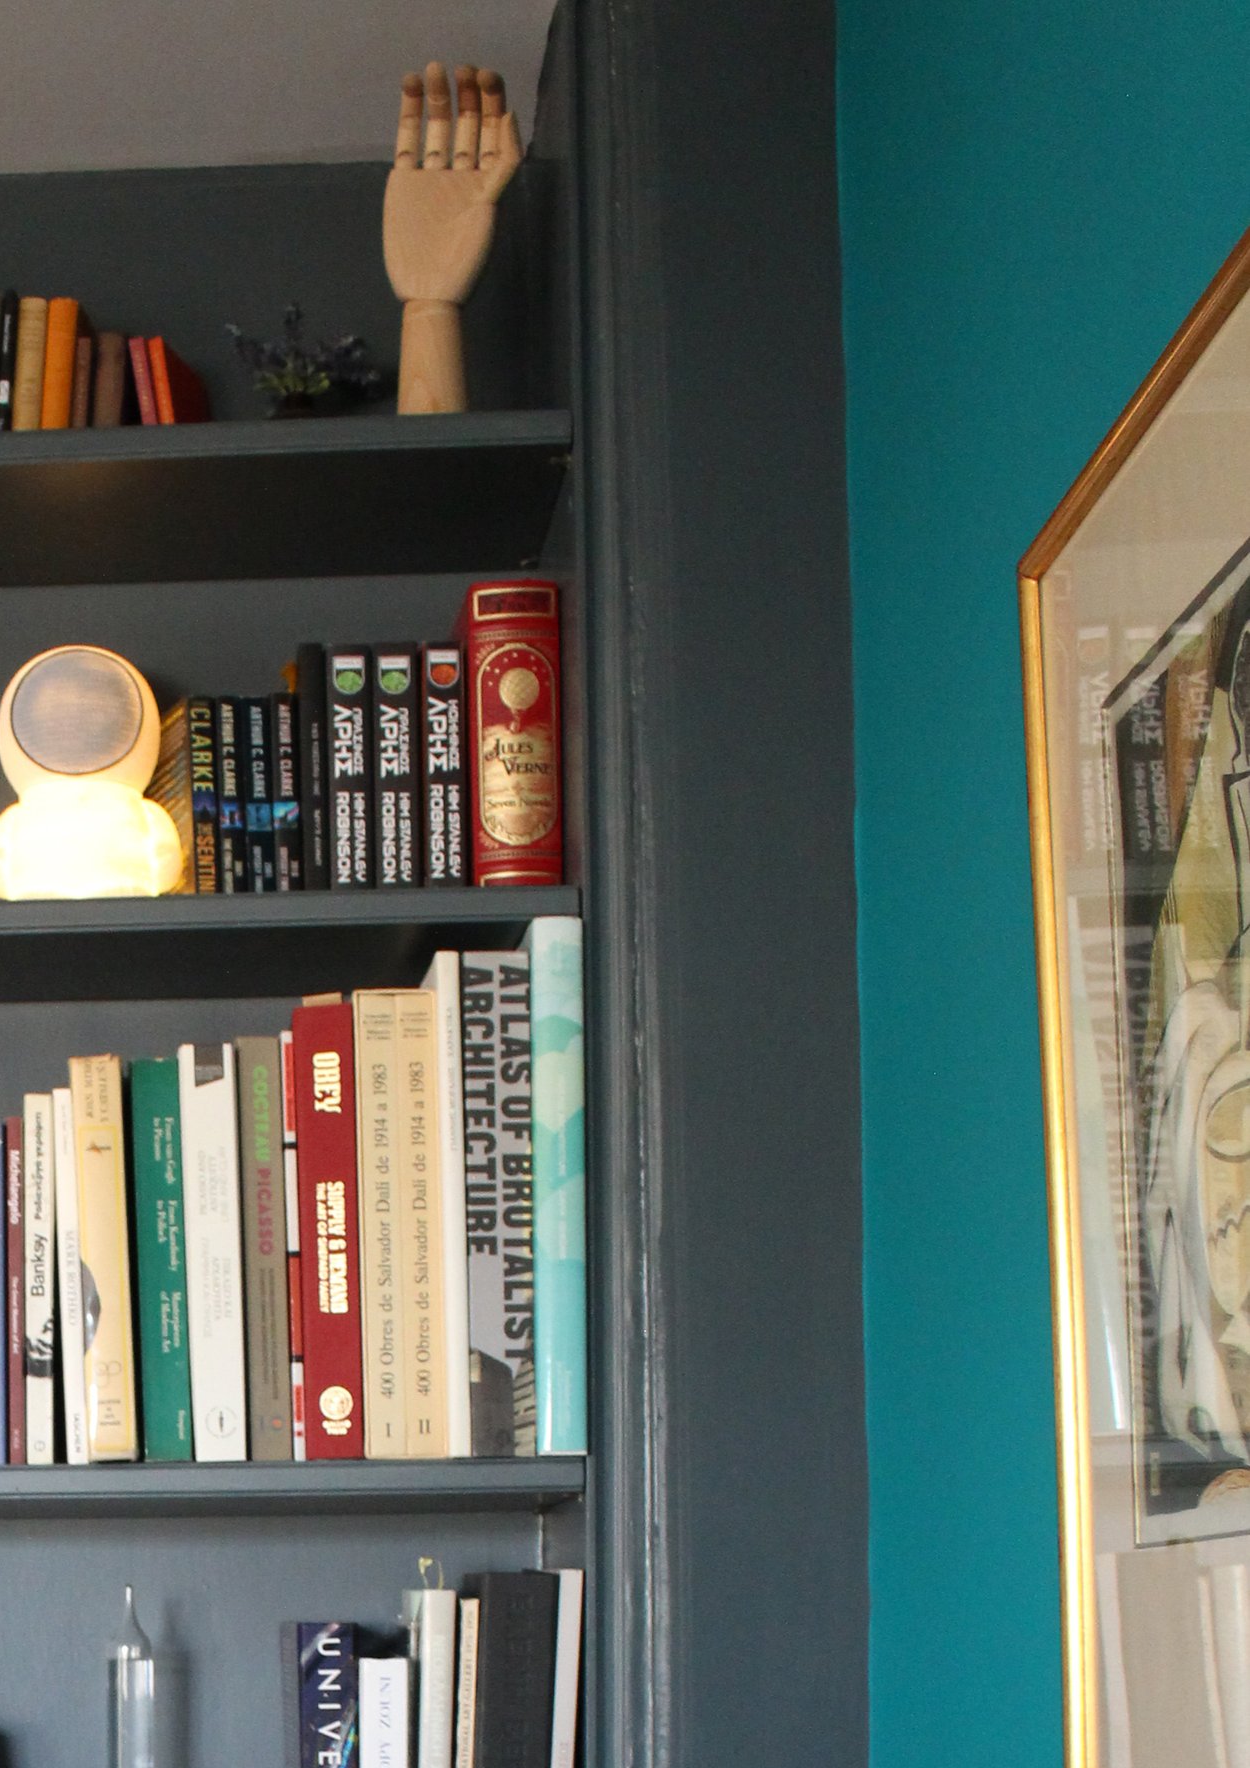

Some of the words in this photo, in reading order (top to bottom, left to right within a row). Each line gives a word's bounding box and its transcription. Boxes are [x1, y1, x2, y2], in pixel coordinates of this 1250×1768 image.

[221, 704, 235, 744] ARTHUR
[250, 706, 263, 745] ARTHUR
[278, 704, 291, 743] ARTHUR
[190, 707, 214, 793] CLARKE
[223, 746, 233, 756] C.
[252, 748, 261, 758] C.
[280, 746, 290, 756] C.
[485, 737, 534, 760] JULES
[501, 757, 553, 776] VERNE
[222, 759, 236, 797] CLARKE
[252, 760, 266, 799] CLARKE
[280, 759, 293, 797] CLARKE
[353, 793, 365, 817] KIM
[399, 793, 411, 817] KIM
[448, 785, 460, 810] KIM
[336, 792, 352, 883] ROBINSON
[382, 792, 397, 883] ROBINSON
[429, 784, 445, 879] ROBINSON
[448, 812, 460, 878] STANLEY
[354, 819, 366, 882] STANLEY
[400, 819, 411, 882] STANLEY
[499, 965, 531, 1084] ATLAS
[313, 1051, 342, 1114] OBEY
[371, 1064, 388, 1095] 1983
[408, 1061, 425, 1094] 1983
[253, 1065, 270, 1161] COCTEAU
[377, 1103, 388, 1111] a
[414, 1100, 425, 1109] a
[465, 967, 497, 1256] ARCHITECTURE
[501, 1096, 532, 1141] OF
[153, 1128, 164, 1161] Picasso
[165, 1117, 175, 1142] From
[374, 1117, 390, 1148] 1914
[410, 1115, 426, 1146] 1914
[165, 1160, 177, 1185] Gogh
[375, 1155, 390, 1175] de
[411, 1153, 426, 1173] de
[7, 1150, 21, 1225] Michelangelo
[316, 1183, 327, 1201] THE
[157, 1211, 168, 1243] Pollock
[168, 1200, 178, 1224] From
[256, 1168, 274, 1257] PICASSO
[316, 1202, 327, 1220] ART
[327, 1181, 346, 1236] SUPPLY
[317, 1222, 327, 1236] OF
[31, 1233, 48, 1297] Banksy
[65, 1231, 77, 1268] MARK
[168, 1226, 181, 1271] Kandinsky
[376, 1220, 392, 1287] Salvador
[413, 1218, 429, 1285] Salvador
[501, 1153, 534, 1365] BRUTALIST
[66, 1272, 79, 1327] ROTHKO
[329, 1253, 349, 1314] DEMAND
[414, 1291, 430, 1310] de
[161, 1304, 171, 1337] Modern
[169, 1292, 182, 1348] Masterpieces
[377, 1294, 393, 1313] de
[162, 1339, 172, 1353] Art
[379, 1320, 394, 1366] Obres
[415, 1317, 431, 1363] Obres
[380, 1372, 395, 1400] 400
[416, 1369, 431, 1397] 400
[379, 1675, 393, 1729] ZOUNI
[463, 1702, 472, 1720] ART
